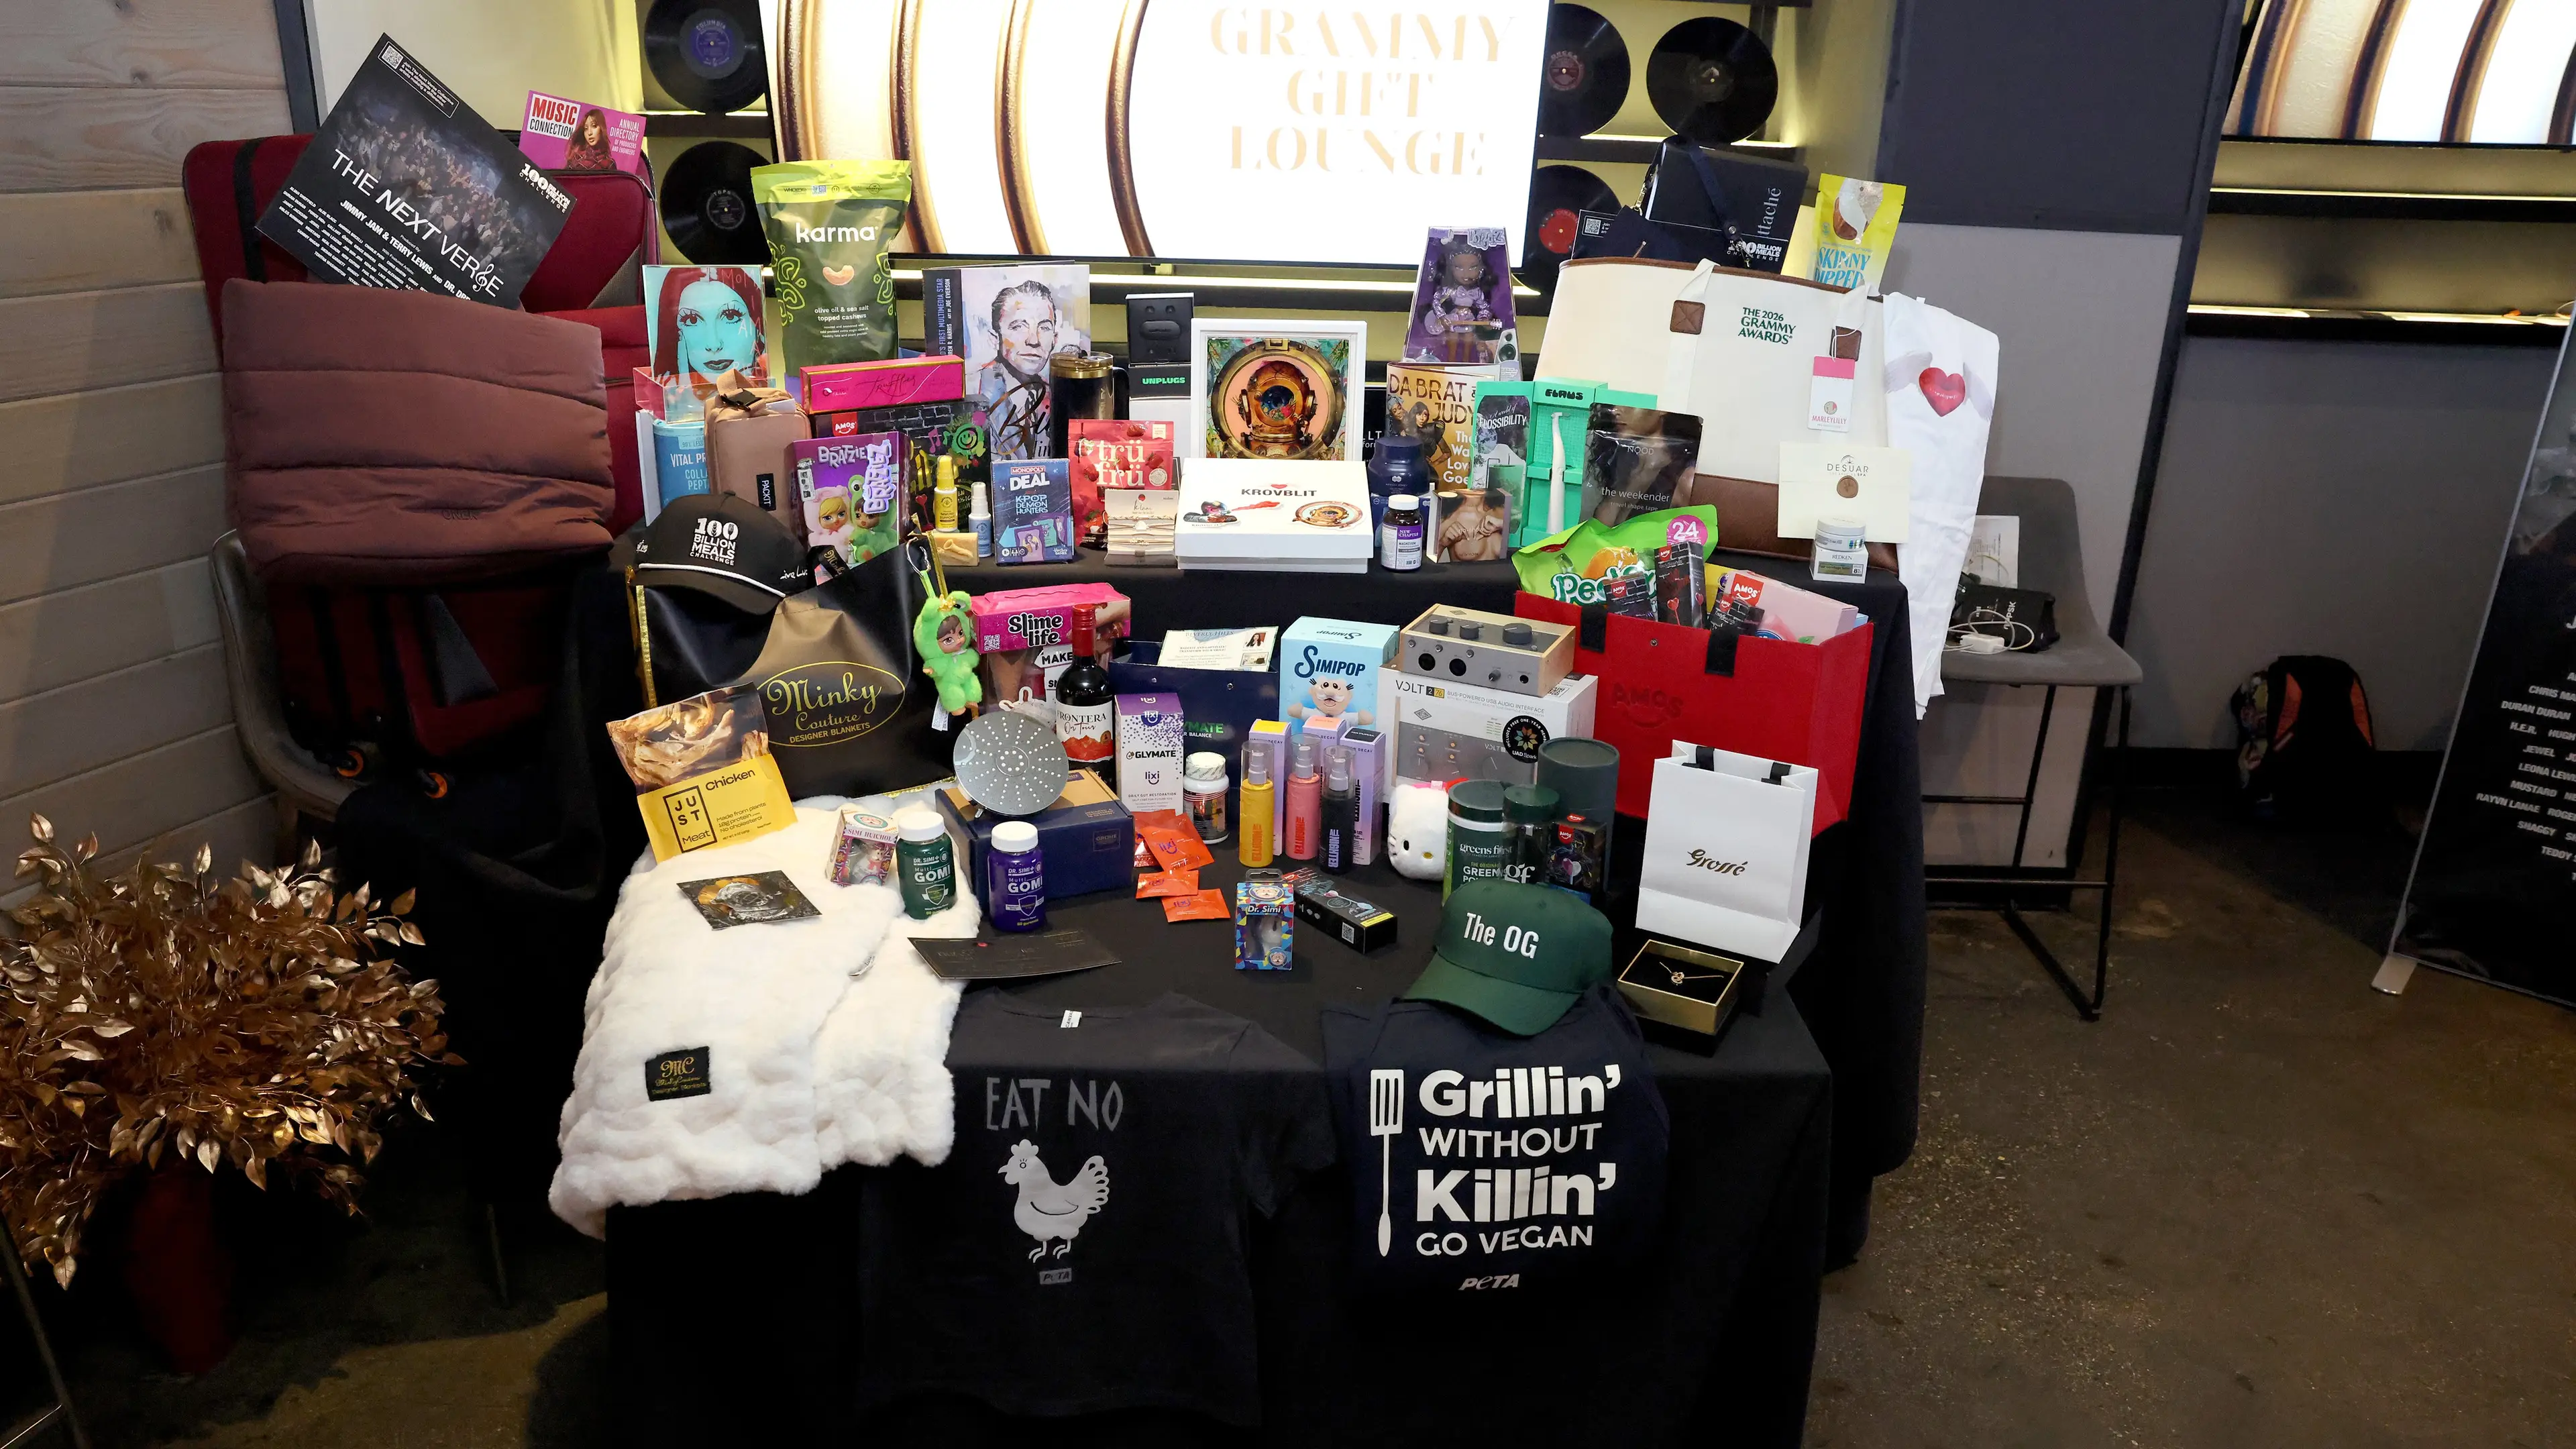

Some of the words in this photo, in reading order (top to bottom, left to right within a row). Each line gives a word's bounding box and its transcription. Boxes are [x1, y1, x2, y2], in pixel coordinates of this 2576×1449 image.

[1211, 7, 1517, 62] GRAMMY
[405, 67, 415, 76] work
[403, 61, 412, 69] Join
[411, 66, 419, 75] The
[418, 73, 428, 83] Next
[427, 80, 437, 91] Verse
[437, 89, 454, 105] Collective
[1287, 68, 1434, 119] GIFT
[532, 97, 578, 125] MUSIC
[529, 118, 574, 138] CONNECTION
[610, 126, 639, 142] DIRECTORY
[619, 118, 639, 132] ANNUAL
[619, 140, 637, 148] PRODUCERS
[619, 147, 635, 156] ENGINEERS
[1230, 125, 1487, 176] LOUNGE
[519, 162, 551, 191] 100
[545, 183, 571, 205] BILLION
[519, 172, 570, 213] CHALLENGE
[545, 187, 570, 209] MEALS
[332, 148, 379, 197] THE
[375, 189, 442, 240] NEXT
[439, 233, 505, 299] VERSE
[796, 222, 876, 243] karma
[340, 200, 368, 221] JIMMY
[365, 219, 384, 235] JAM
[382, 231, 390, 241] &
[389, 236, 413, 258] TERRY
[411, 254, 433, 275] LEWIS
[432, 274, 443, 284] AND
[443, 280, 455, 294] DR.
[1756, 249, 1780, 257] MEALS
[1758, 244, 1782, 252] BILLION
[1819, 246, 1871, 270] SKINNY
[936, 294, 945, 327] MULTIMEDIA
[1743, 307, 1761, 317] THE
[1762, 311, 1784, 322] 2026
[1741, 316, 1796, 334] GRAMMY
[1738, 327, 1790, 345] AWARDS
[1389, 374, 1411, 397] DA
[1416, 378, 1466, 402] BRAT
[835, 422, 857, 431] AMOS
[1479, 414, 1527, 430] FLOSSIBILITY
[1812, 415, 1847, 425] MARLEYLILLY
[1097, 439, 1145, 463] trü
[1627, 446, 1654, 455] NOOD
[670, 453, 694, 468] VITAL
[1827, 464, 1869, 474] DESUAR
[1010, 472, 1050, 491] DEAL
[1097, 461, 1145, 486] frü
[761, 480, 771, 506] PACKIT
[1016, 494, 1047, 502] K-POP
[1241, 489, 1317, 497] KROVBLIT
[1602, 487, 1617, 496] the
[1619, 490, 1670, 502] weekender
[1016, 500, 1047, 508] DEMON
[1627, 503, 1644, 511] shape
[694, 517, 739, 541] 100
[1672, 521, 1699, 540] 24
[691, 542, 735, 559] MEALS
[694, 534, 736, 550] BILLION
[690, 551, 735, 566] CHALLENGE
[1734, 582, 1760, 596] AMOS
[1721, 599, 1731, 608] AMOS
[1009, 613, 1063, 638] Slime
[1028, 629, 1061, 647] life
[1042, 652, 1073, 665] MAKE
[1295, 645, 1366, 678] SIMIPOP
[766, 671, 883, 716] Minky
[1396, 680, 1424, 694] VOLT
[1447, 690, 1485, 702] BUS-POWERED
[1515, 704, 1544, 714] INTERFACE
[2528, 684, 2559, 699] CHRIS
[1057, 710, 1107, 722] FRONTERA
[2502, 700, 2535, 714] DURAN
[2536, 706, 2571, 721] DURAN
[794, 712, 861, 732] Couture
[2510, 721, 2537, 735] H.E.R.
[789, 729, 828, 744] DESIGNER
[830, 722, 871, 739] BLANKETS
[1135, 750, 1177, 759] GLYMATE
[2523, 745, 2555, 757] JEWEL
[1145, 771, 1159, 782] lixi
[2518, 763, 2550, 777] LEONA
[705, 769, 756, 791] Chicken
[2510, 780, 2558, 798] MUSTARD
[716, 814, 733, 822] Made
[734, 808, 749, 816] from
[749, 802, 766, 812] plants
[2476, 792, 2508, 807] RAYVN
[2510, 799, 2541, 814] LANAE
[718, 820, 730, 828] 18g
[730, 814, 752, 825] protein
[729, 816, 763, 830] cholesterol
[2518, 820, 2557, 837] SHAGGY
[682, 829, 711, 845] Meat
[848, 828, 862, 837] SIMI
[864, 832, 892, 842] HUICHOL
[1460, 843, 1492, 854] greens
[2541, 846, 2573, 861] TEDDY
[914, 866, 951, 883] GOMI
[1008, 876, 1042, 893] GOMI
[1463, 912, 1496, 946] The
[1503, 925, 1540, 959] OG
[660, 1057, 694, 1077] MC
[1418, 1063, 1621, 1118] Grillin'
[987, 1077, 1051, 1132] EAT
[1068, 1079, 1124, 1132] NO
[1418, 1122, 1603, 1158] WITHOUT
[1417, 1163, 1617, 1223] Killin'
[1416, 1232, 1468, 1256] GO
[1479, 1226, 1593, 1254] VEGAN
